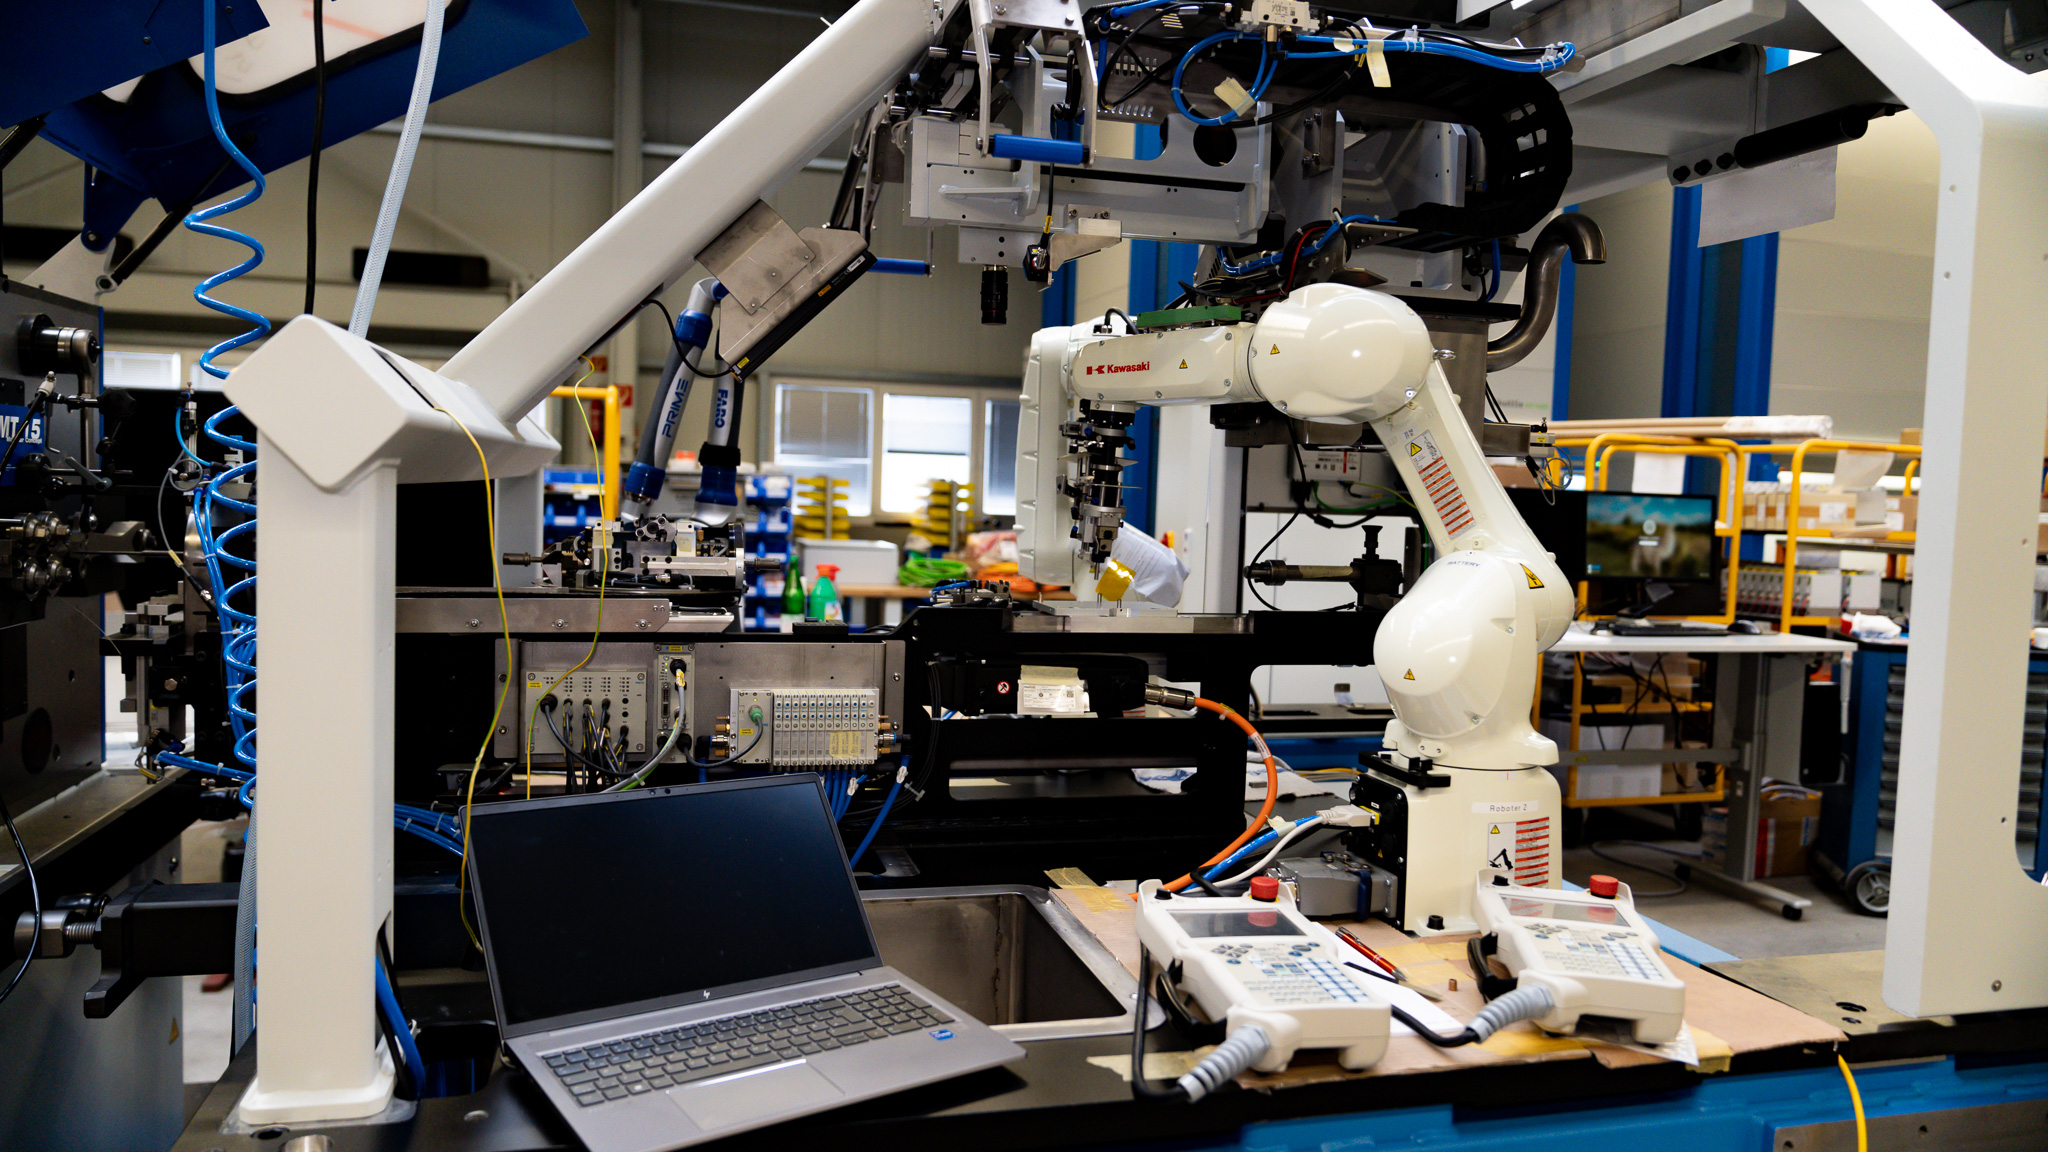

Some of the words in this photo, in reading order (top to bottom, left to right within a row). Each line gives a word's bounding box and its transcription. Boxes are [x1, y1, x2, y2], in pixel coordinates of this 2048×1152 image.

[1107, 361, 1150, 374] Kawasaki
[661, 378, 689, 438] PRIME
[714, 388, 729, 429] FARO
[1489, 804, 1521, 812] Roboter
[1523, 803, 1527, 811] 2
